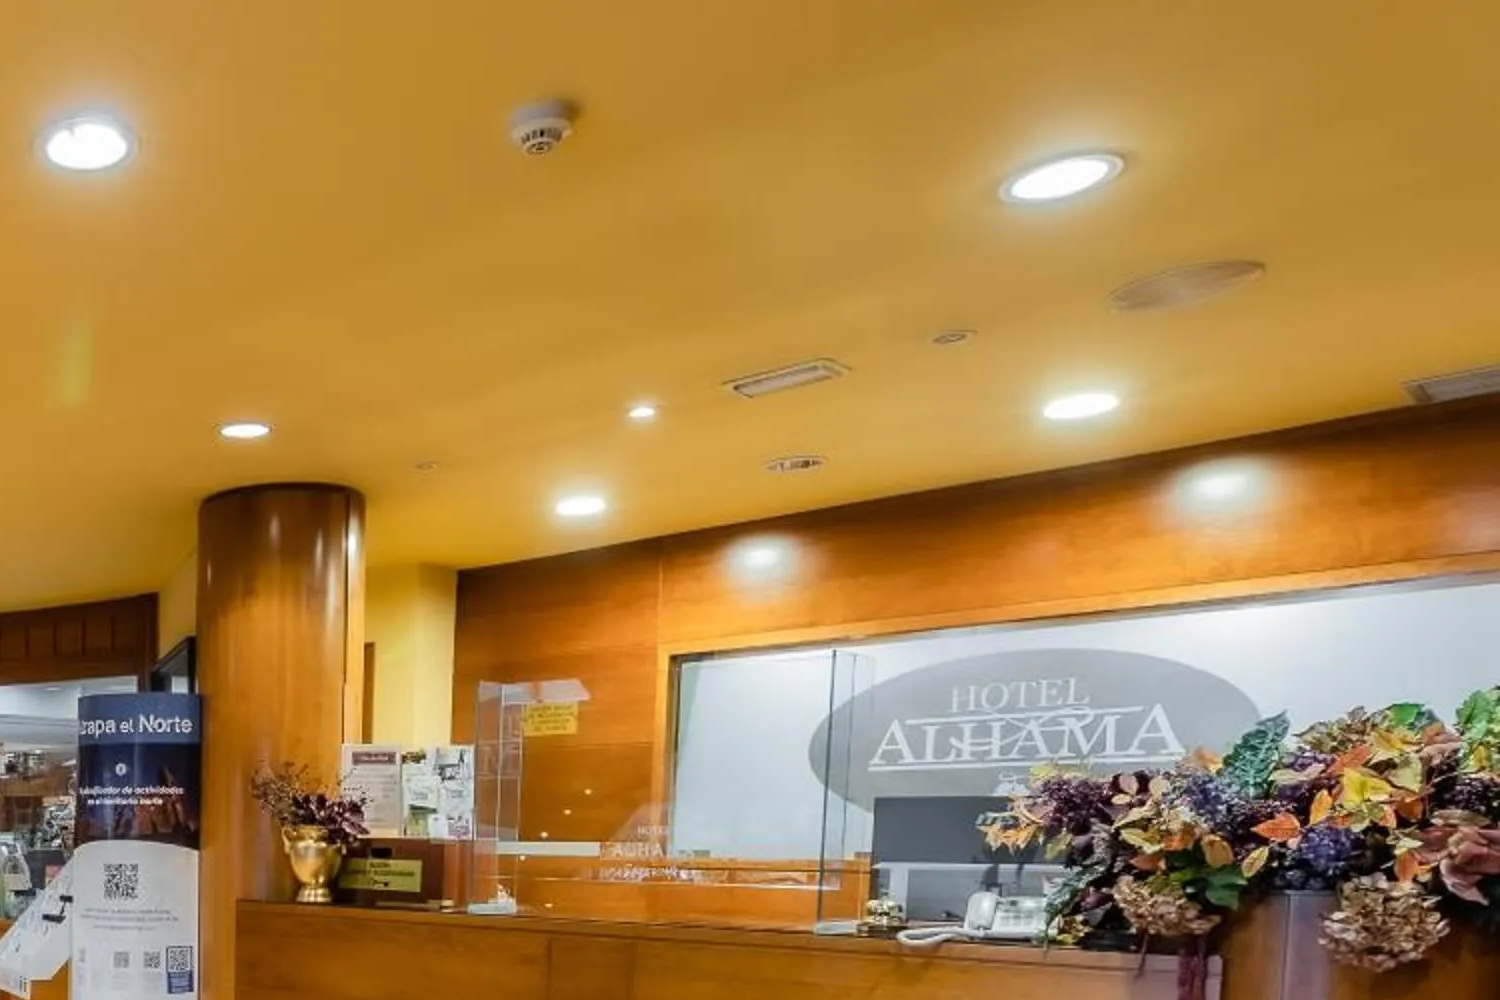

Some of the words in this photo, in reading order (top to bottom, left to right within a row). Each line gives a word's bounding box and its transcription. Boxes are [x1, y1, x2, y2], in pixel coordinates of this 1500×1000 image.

[952, 677, 1090, 713] HOTEL
[119, 718, 135, 734] el
[138, 713, 194, 734] Norte
[869, 703, 1187, 764] ALHAMA
